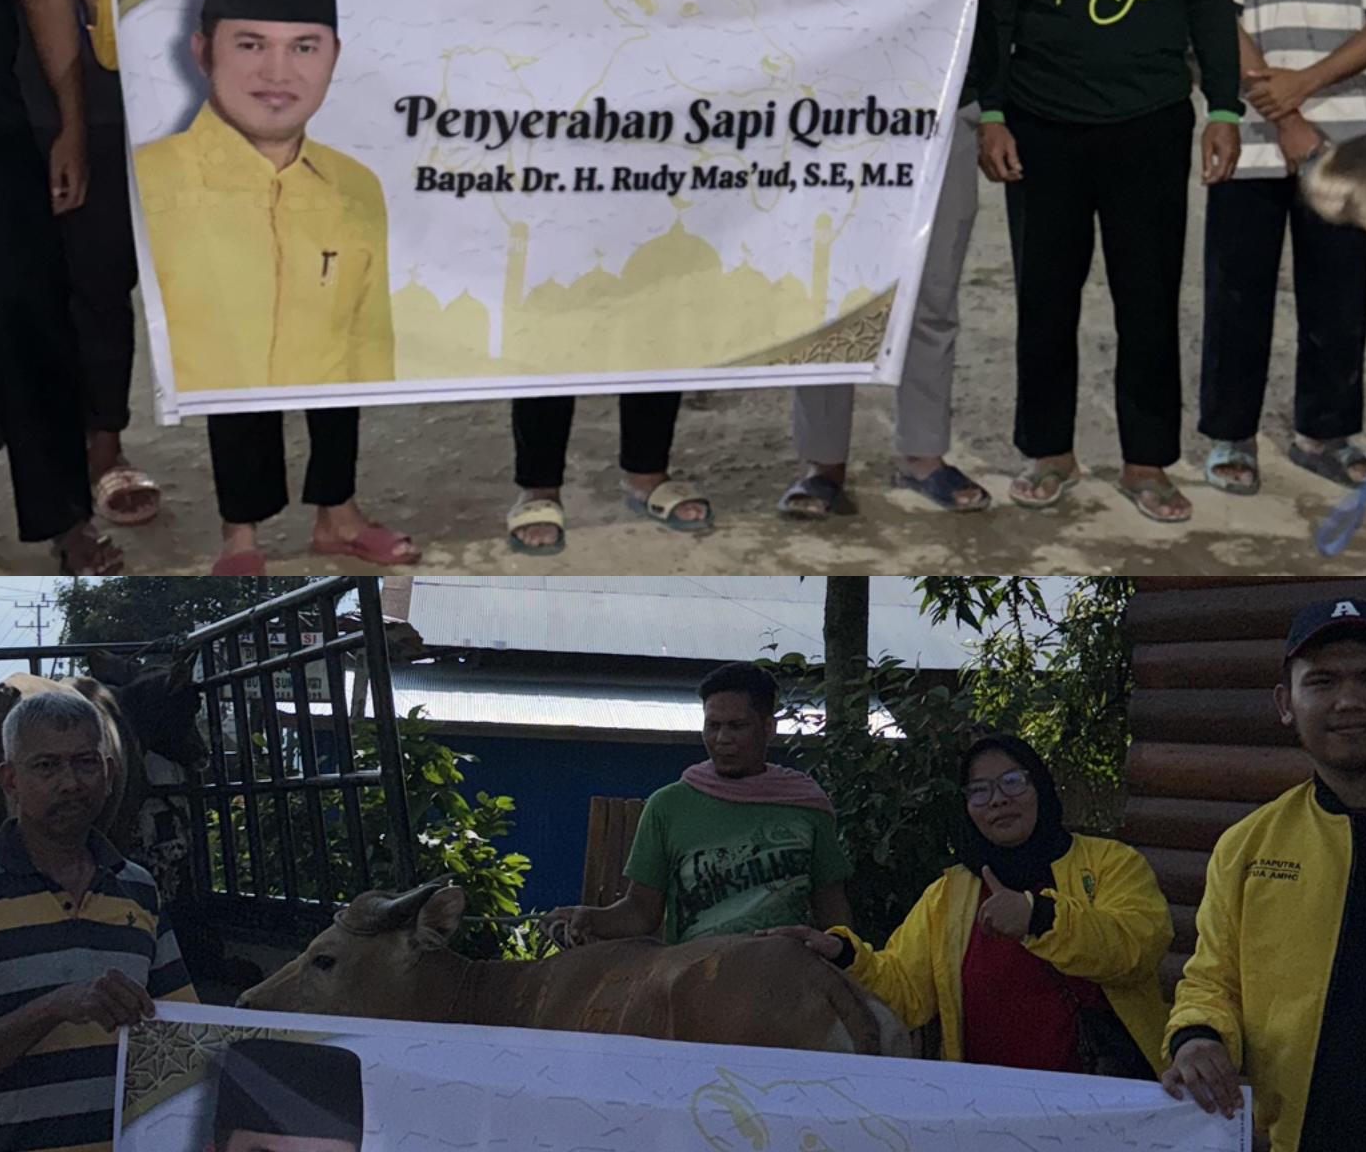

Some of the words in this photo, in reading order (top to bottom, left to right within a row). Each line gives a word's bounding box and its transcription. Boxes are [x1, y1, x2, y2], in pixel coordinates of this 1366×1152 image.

[395, 96, 673, 150] Penyerahan
[685, 99, 775, 150] Sapi
[789, 96, 936, 148] Qurban
[416, 165, 514, 198] Bapak
[521, 167, 565, 192] Dr.
[574, 167, 604, 191] H.
[612, 164, 686, 197] Rudy
[804, 163, 854, 192] S.E,
[861, 163, 913, 186] M.E
[1331, 601, 1360, 618] A
